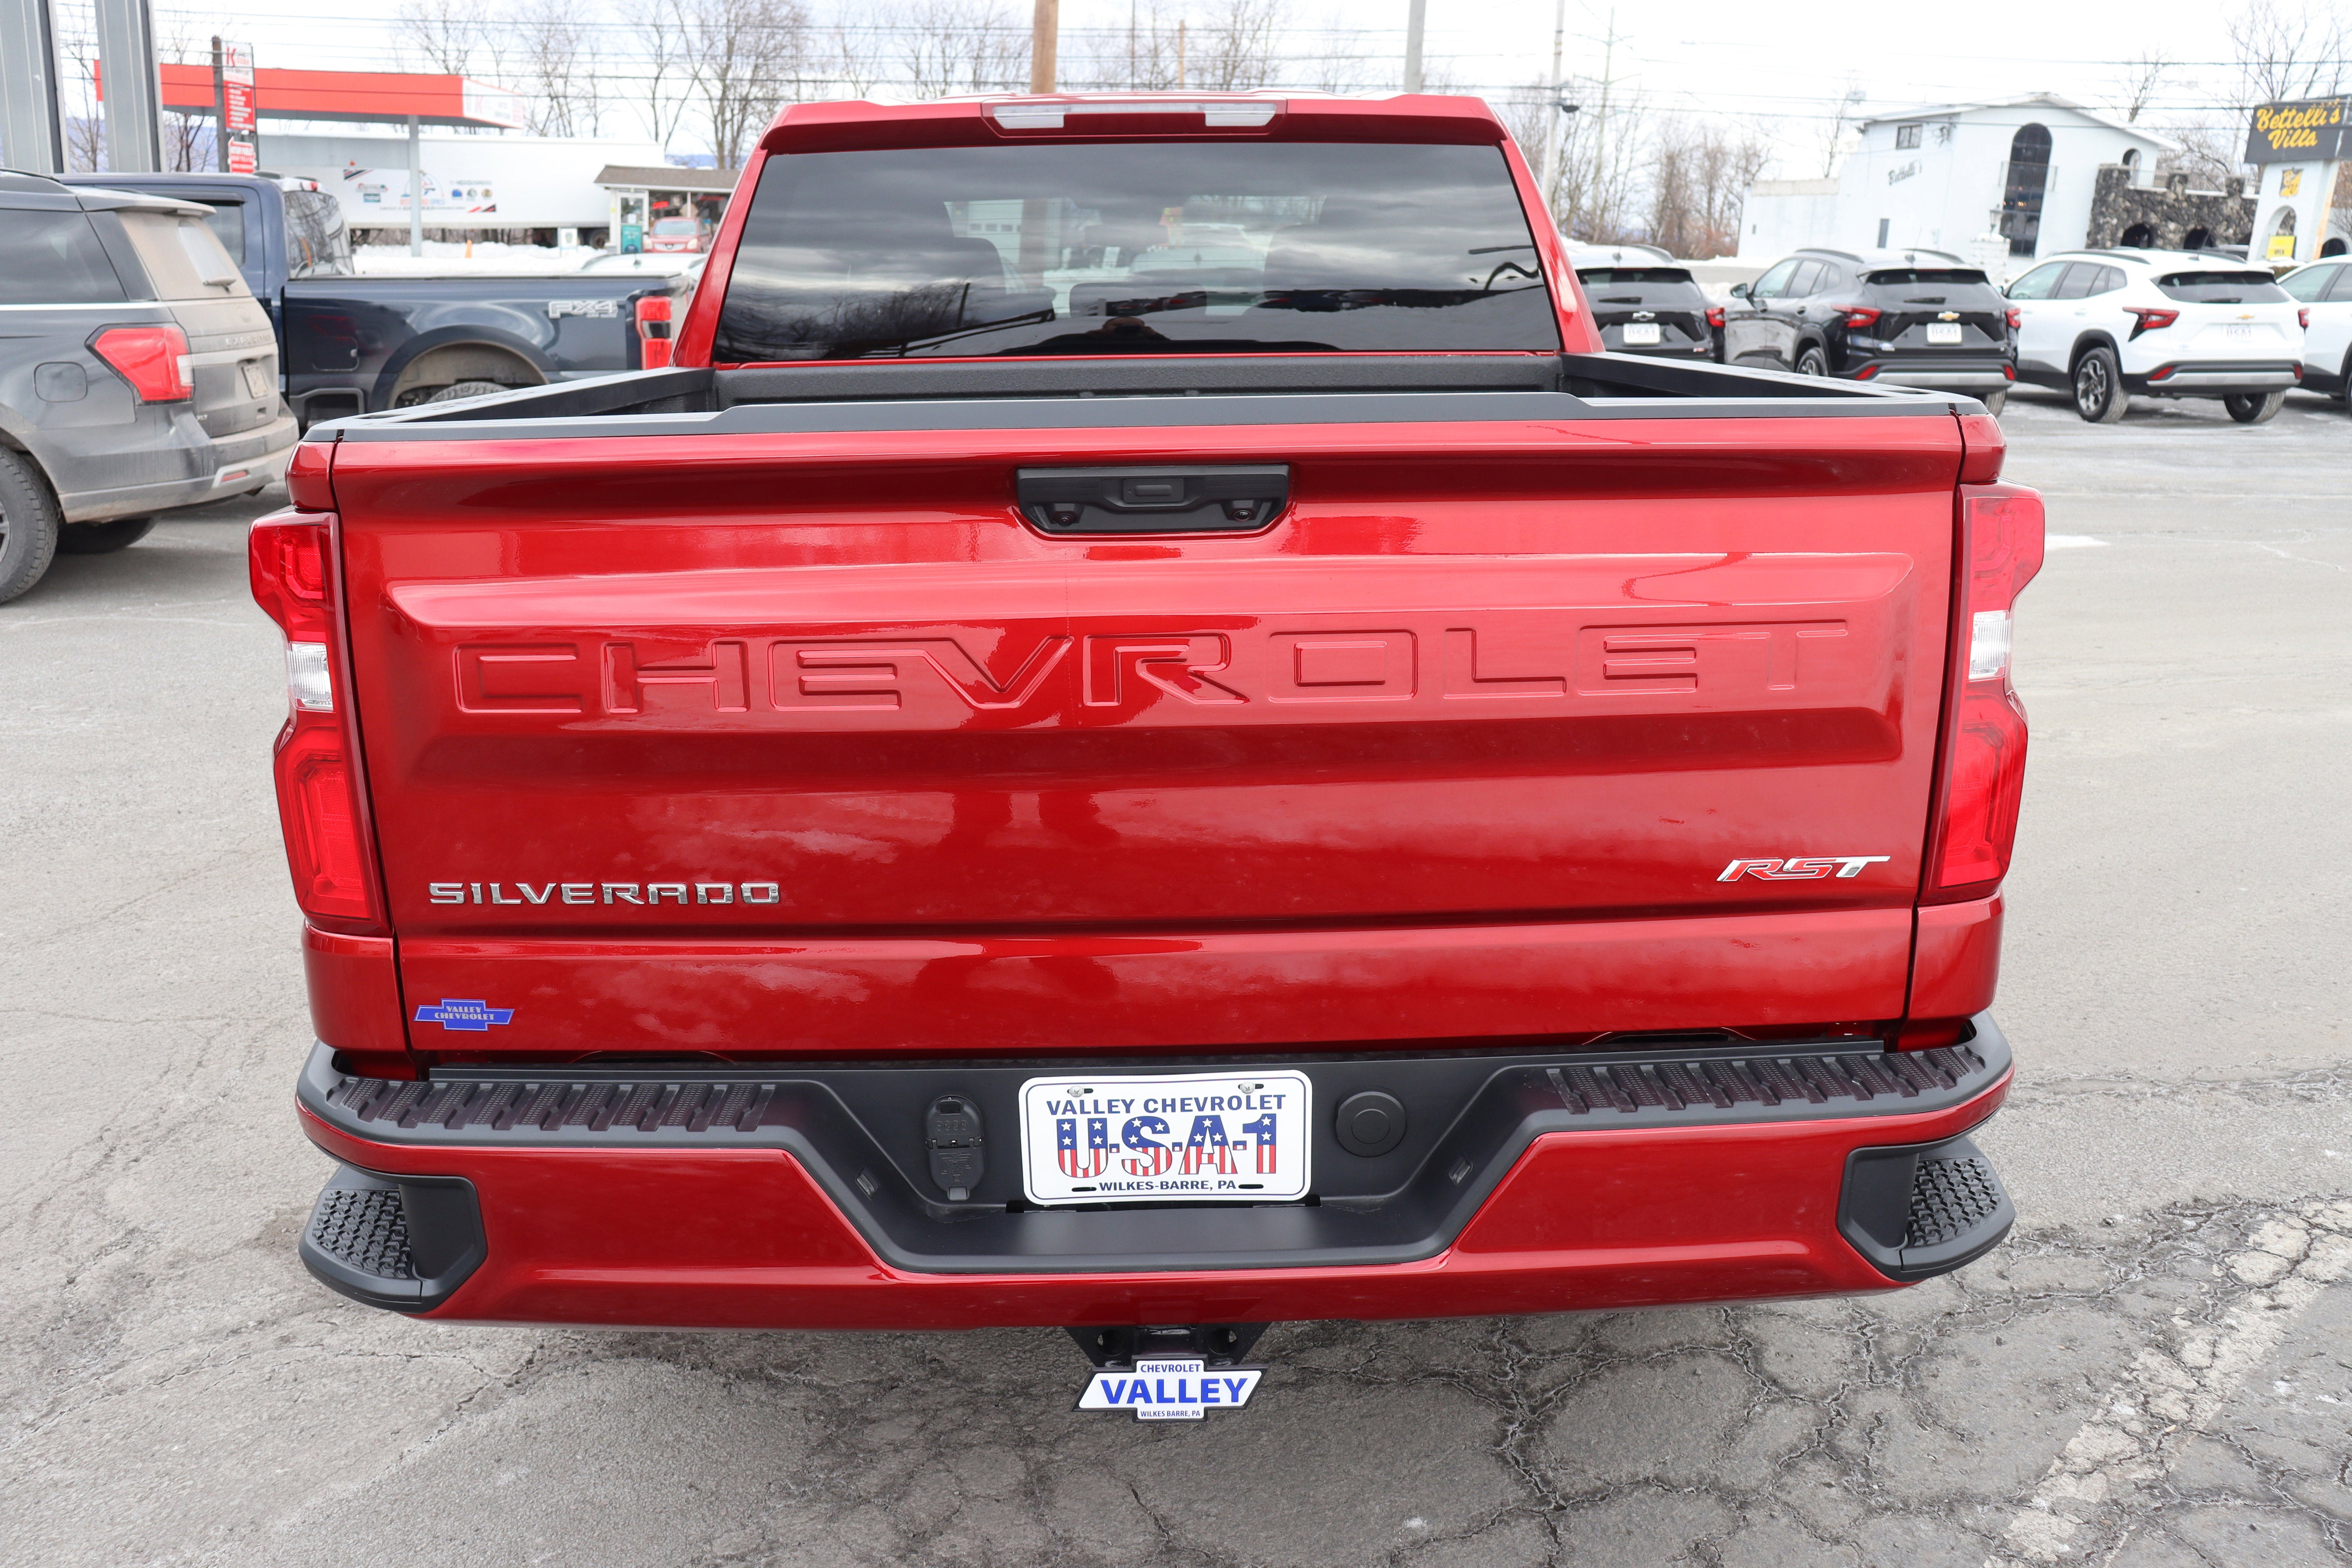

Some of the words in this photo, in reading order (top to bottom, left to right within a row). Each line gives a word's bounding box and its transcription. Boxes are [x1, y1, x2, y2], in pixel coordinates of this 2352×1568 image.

[2256, 99, 2341, 132] Bettelli's
[2268, 128, 2318, 150] Villa
[548, 300, 618, 318] FX4
[453, 619, 1848, 713] CHEVROLET
[1716, 856, 1891, 882] RST
[429, 882, 780, 905] SILVERADO
[434, 1012, 494, 1020] CHEVROLET
[1047, 1098, 1135, 1115] VALLEY
[1143, 1095, 1286, 1113] CHEVROLET
[1099, 1180, 1213, 1191] WILKES-BARRE,
[1218, 1180, 1236, 1189] PA
[1140, 1364, 1200, 1373] CHEVROLET
[1100, 1378, 1248, 1404] VALLEY
